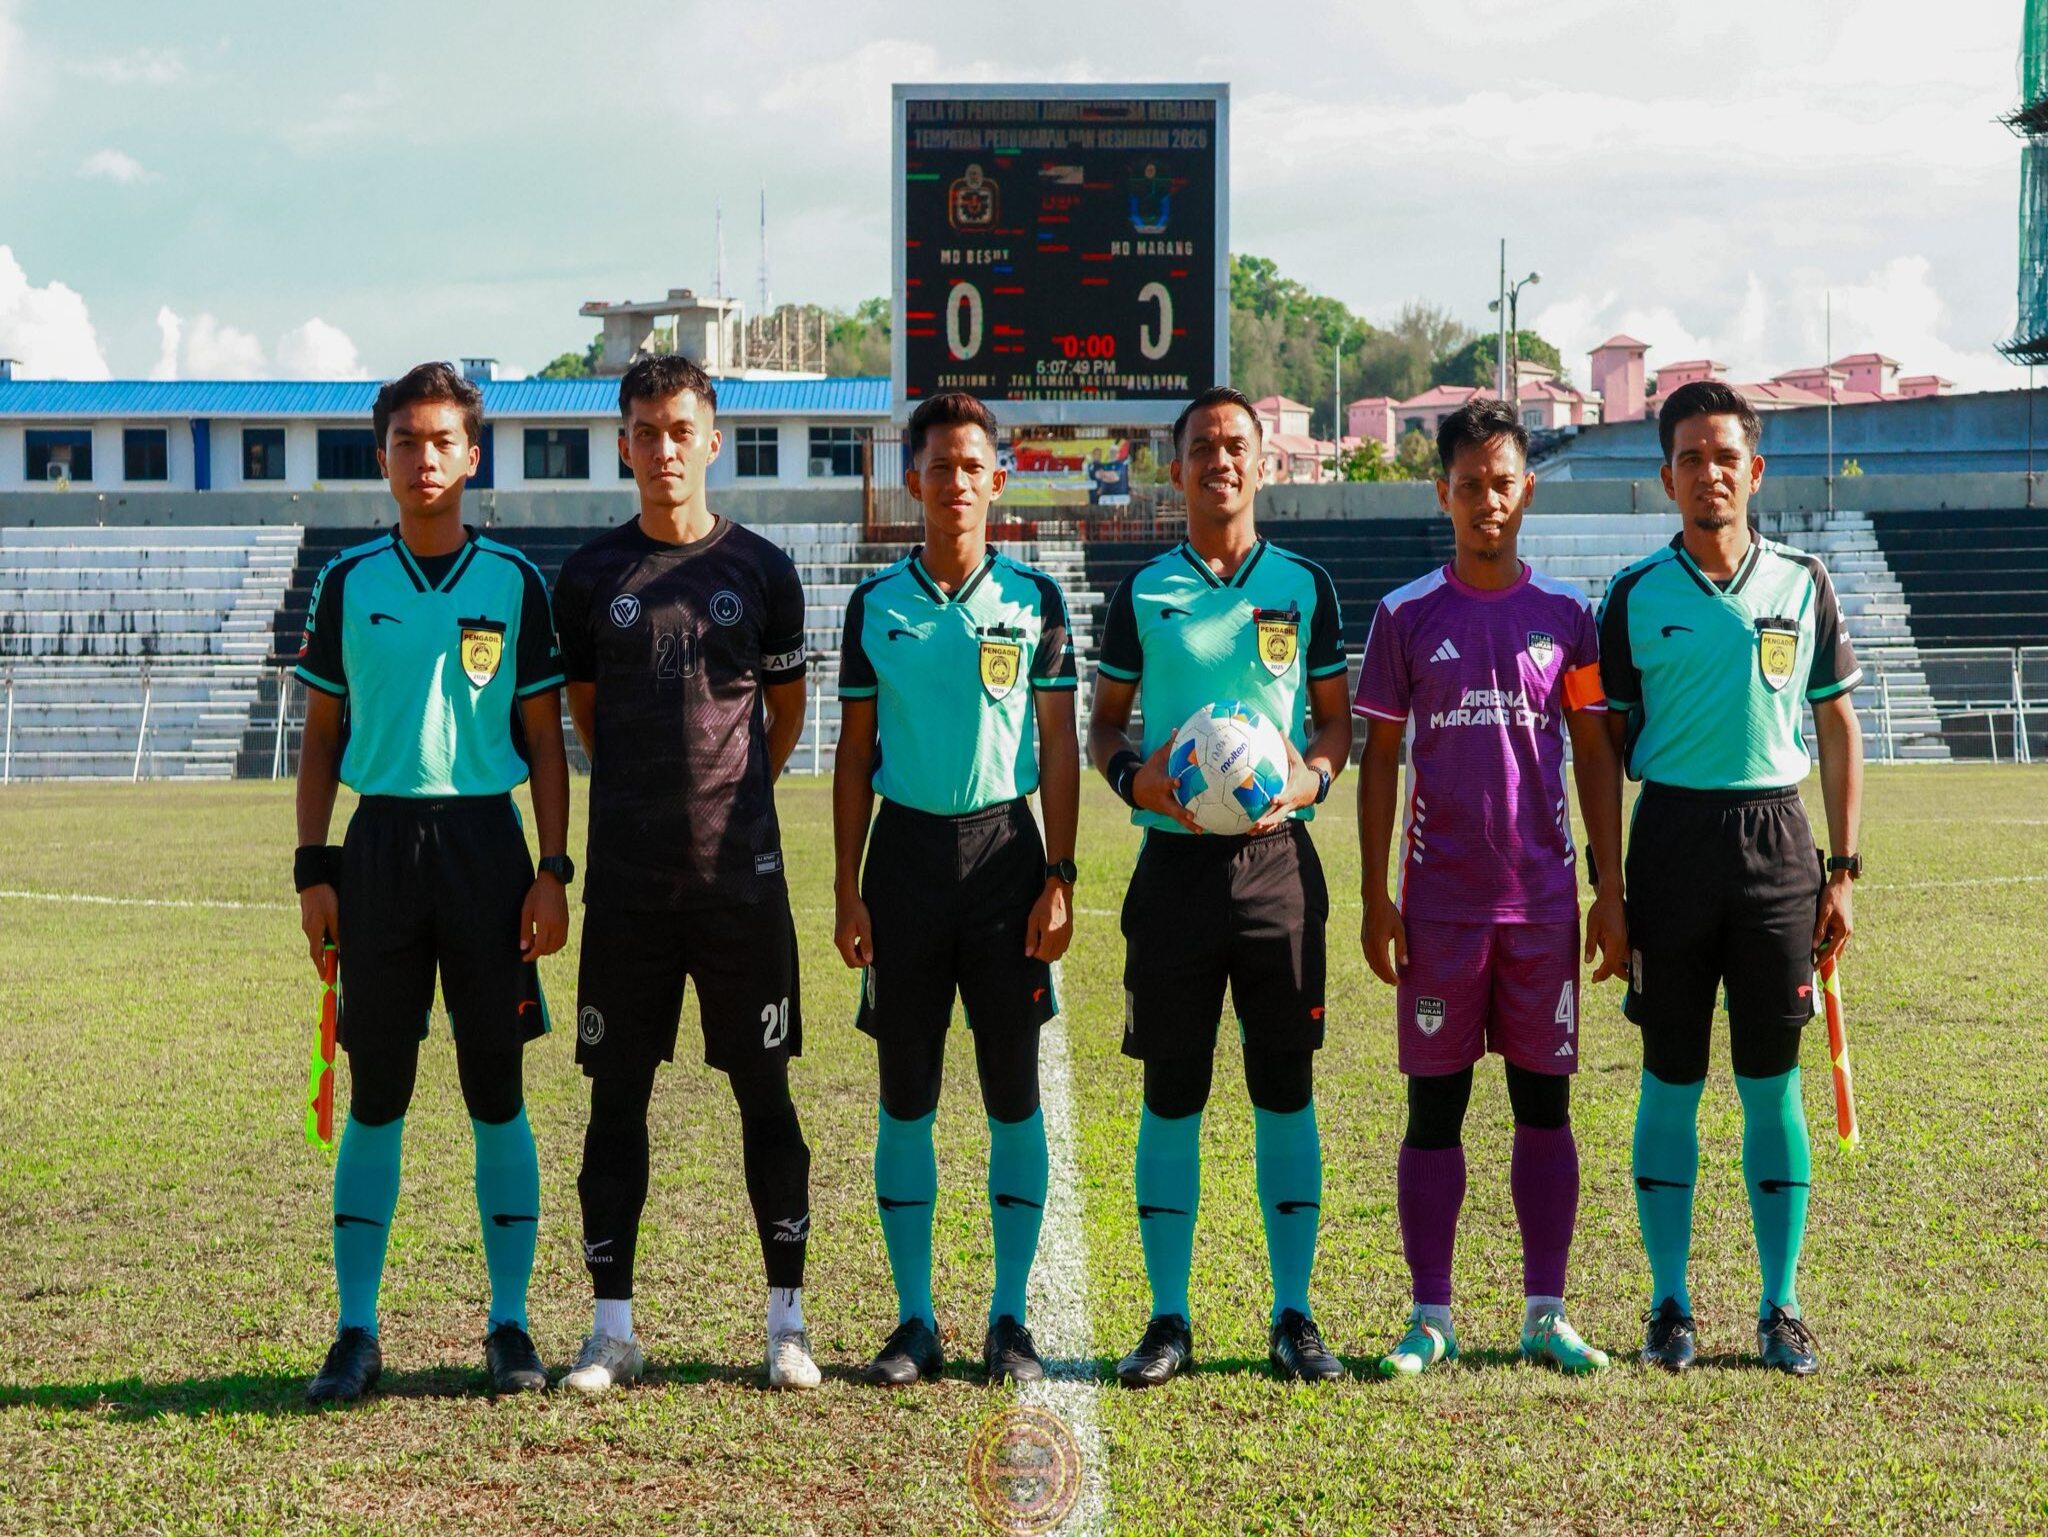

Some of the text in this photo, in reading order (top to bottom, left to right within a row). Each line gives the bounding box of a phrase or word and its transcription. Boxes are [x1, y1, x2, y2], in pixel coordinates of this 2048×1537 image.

[1136, 241, 1193, 256] MARANG
[946, 282, 983, 360] 0
[1093, 360, 1116, 374] PM
[464, 634, 500, 643] PENGADIL
[1260, 626, 1296, 635] PENGADIL
[656, 632, 697, 679] 20
[983, 647, 1018, 657] PENGADIL
[1461, 689, 1527, 709] ARENA
[1430, 708, 1511, 730] MARANG
[1220, 742, 1248, 774] molten
[1555, 979, 1575, 1034] 4
[761, 997, 789, 1049] 20
